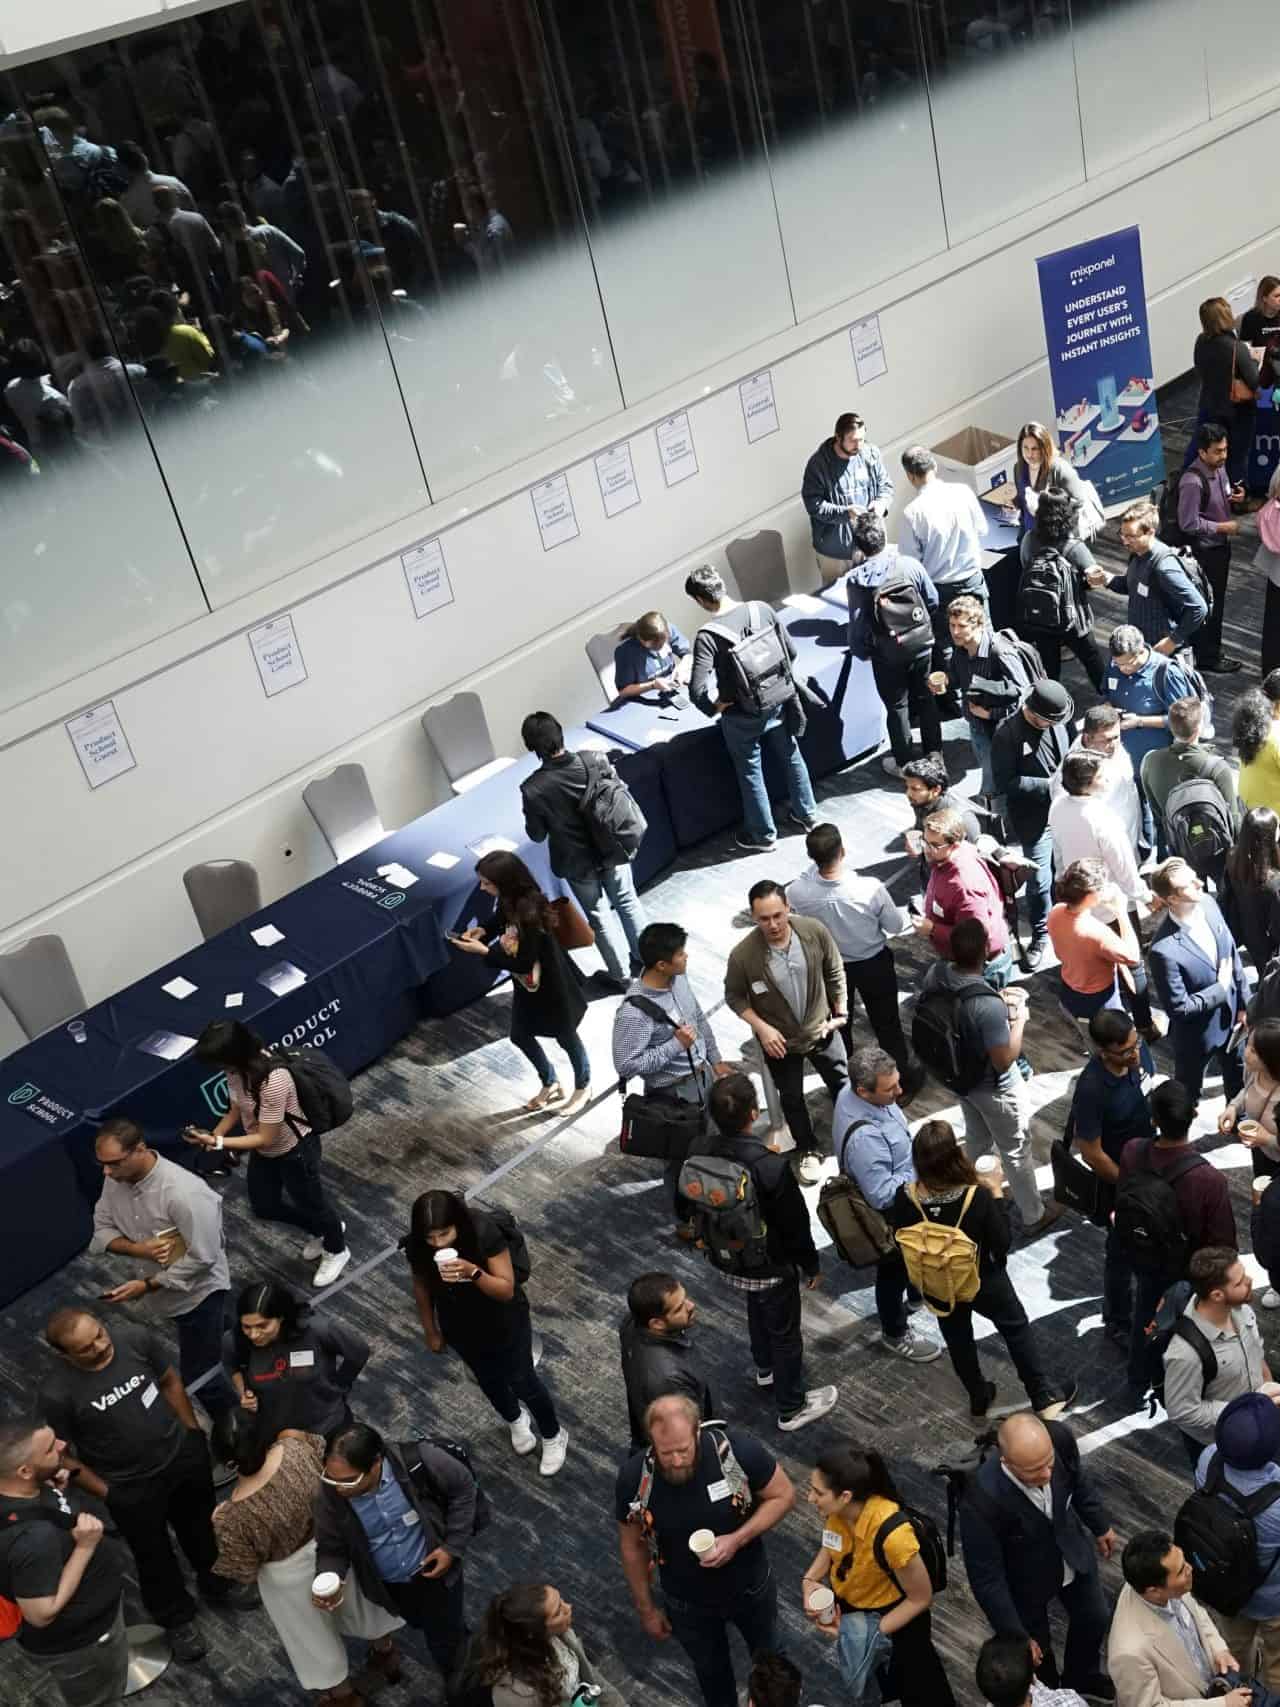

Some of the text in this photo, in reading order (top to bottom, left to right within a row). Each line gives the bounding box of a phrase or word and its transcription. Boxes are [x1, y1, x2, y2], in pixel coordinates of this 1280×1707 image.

[1069, 254, 1116, 280] mixpanel
[1064, 285, 1127, 313] UNDERSTAND
[1066, 300, 1129, 329] EVERY USER'S
[1066, 313, 1133, 345] JOURNEY WITH
[1061, 326, 1141, 361] INSTANT INSIGHTS
[84, 730, 115, 750] Product
